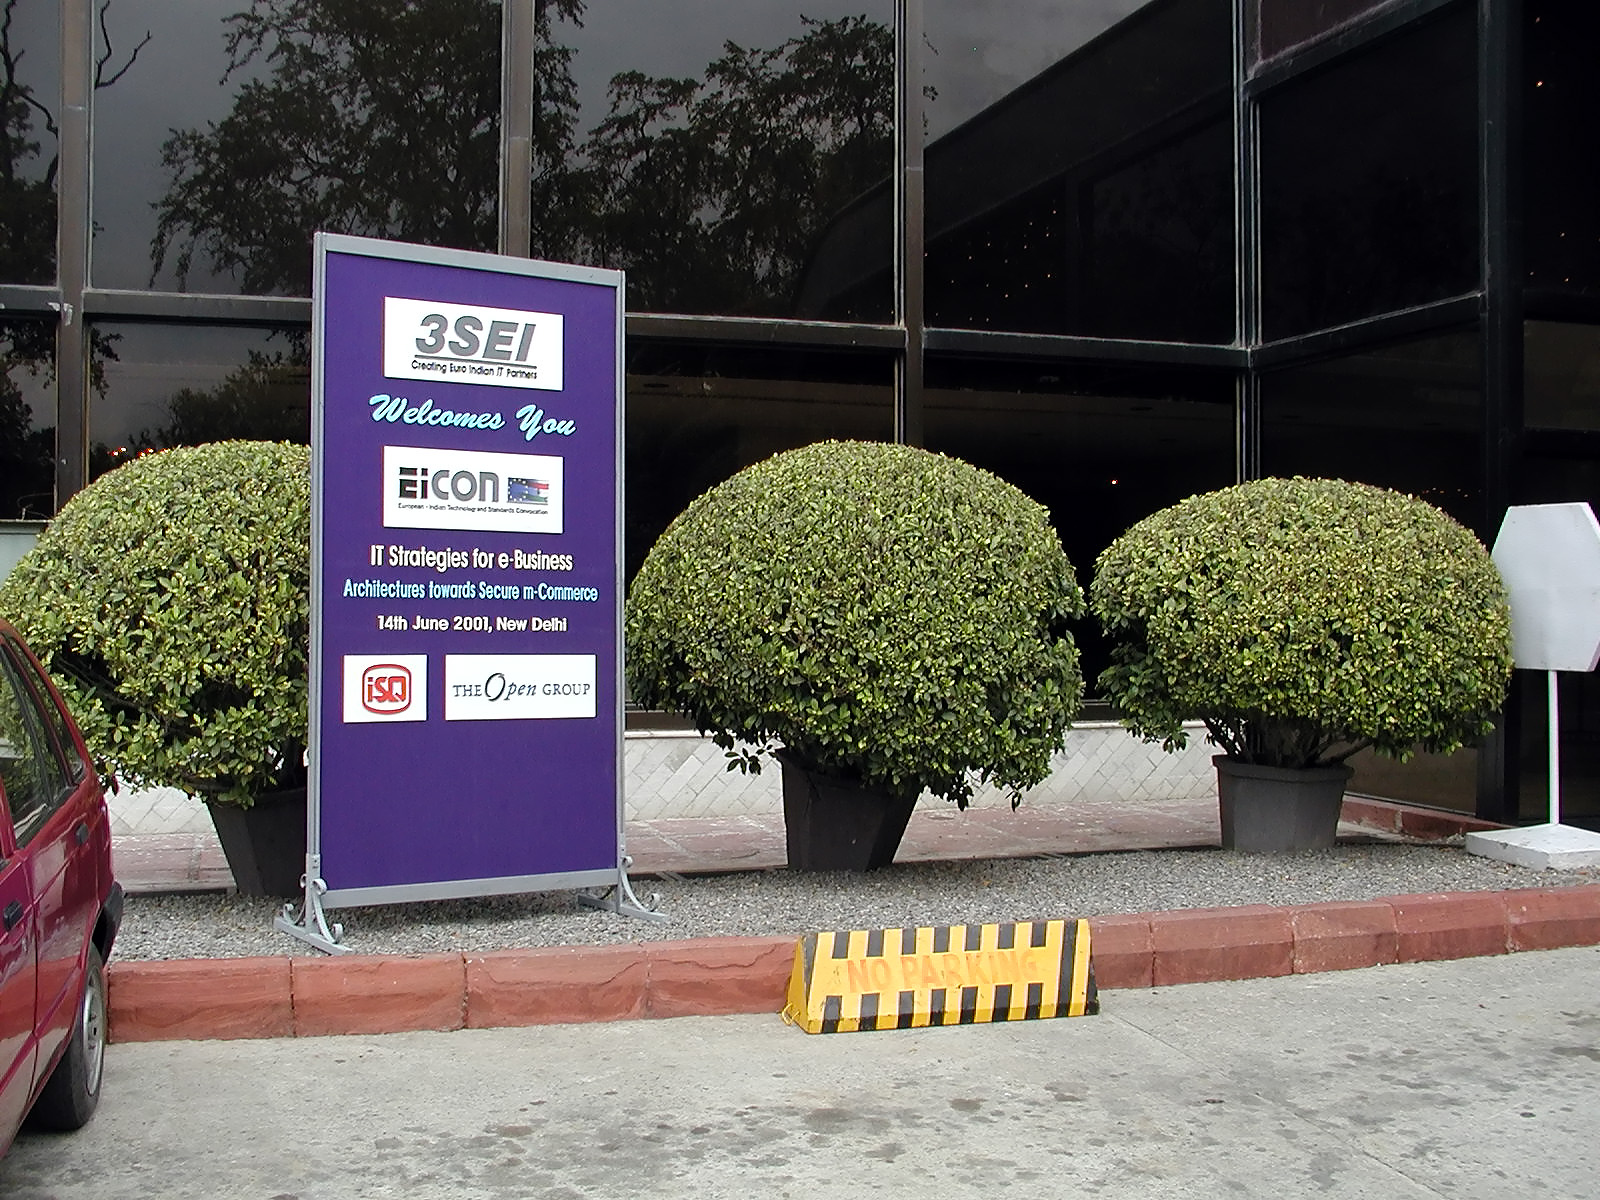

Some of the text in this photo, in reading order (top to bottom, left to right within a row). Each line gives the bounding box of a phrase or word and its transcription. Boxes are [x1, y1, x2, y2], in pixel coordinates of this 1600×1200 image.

[415, 313, 537, 362] 3SEI
[411, 359, 537, 379] Creating Euro Indian IT Partners
[368, 394, 577, 441] Welcomes You
[370, 545, 574, 572] IT Strategies for e-Business
[343, 578, 599, 602] Architectures towards Secure m-Commerce
[377, 615, 568, 633] 14th June 2001, New Delhi
[452, 672, 591, 702] THE Open GROUP
[847, 950, 1039, 993] NO PARKING
